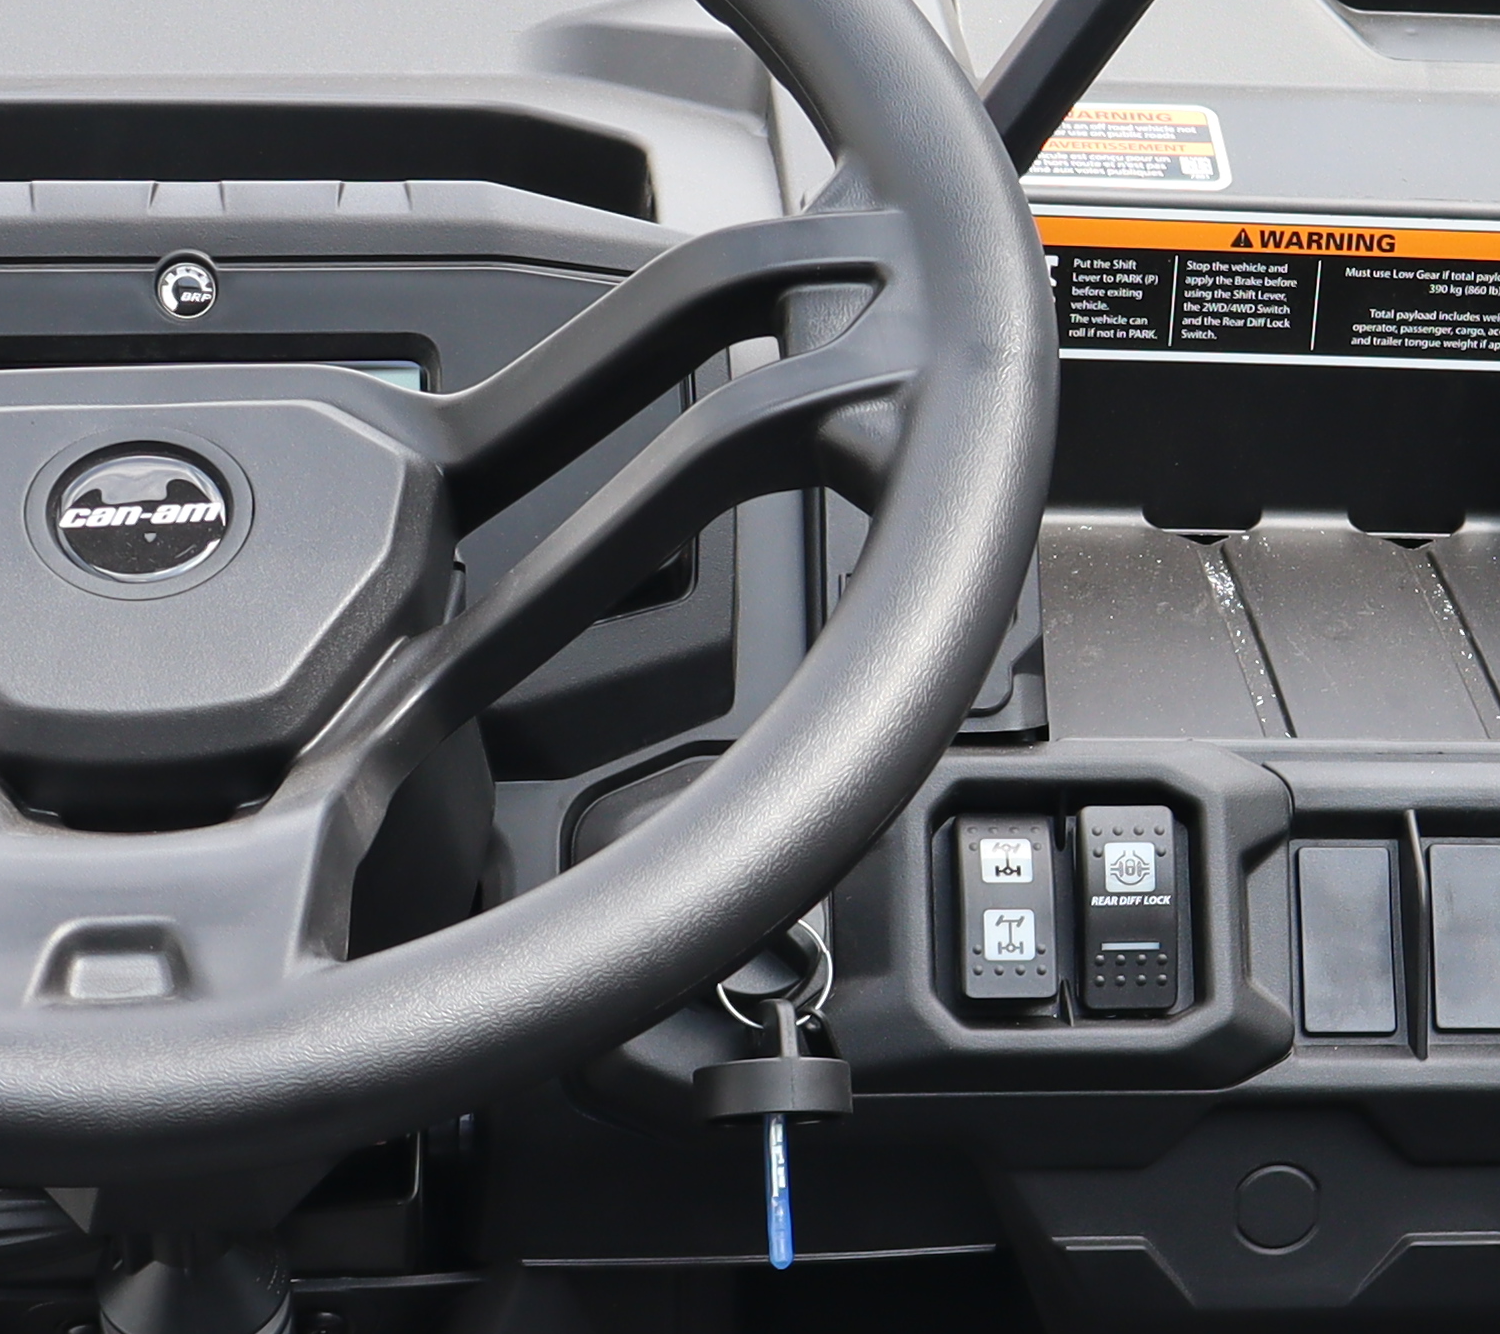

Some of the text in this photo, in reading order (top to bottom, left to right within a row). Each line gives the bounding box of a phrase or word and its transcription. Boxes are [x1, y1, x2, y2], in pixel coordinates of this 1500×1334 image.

[1049, 140, 1187, 153] AVERTISSEMENT
[1260, 230, 1396, 253] WARNING
[1073, 257, 1137, 270] Put the Shift
[1186, 260, 1288, 273] Stop the vehicle and
[1072, 272, 1159, 285] Lever to PARK (P)
[1345, 267, 1371, 278] Must
[1372, 270, 1391, 278] use
[1392, 268, 1415, 279] Low
[1415, 269, 1440, 280] Gear
[1441, 269, 1450, 280] if
[1450, 270, 1475, 281] total
[1184, 274, 1297, 288] apply the Brake before
[1071, 285, 1143, 300] before exiting
[1184, 288, 1212, 301] using
[1213, 288, 1231, 299] the
[1232, 289, 1256, 300] Shift
[1428, 283, 1448, 294] 390
[1449, 283, 1462, 297] kg
[1464, 284, 1487, 295] (860
[1183, 301, 1290, 314] the 2WD/4WD Switch
[1069, 313, 1148, 325] The vehicle can
[1181, 315, 1290, 328] and the Rear Diff Lock
[1369, 308, 1395, 319] Total
[1395, 309, 1437, 322] payload
[1438, 310, 1480, 322] includes
[1068, 327, 1086, 337] roll
[1087, 327, 1095, 337] if
[1096, 329, 1114, 338] not
[1116, 328, 1127, 338] in
[1350, 335, 1371, 345] and
[1372, 336, 1403, 346] trailer
[1404, 337, 1441, 349] tongue
[1442, 338, 1478, 351] weight
[1479, 338, 1488, 349] if
[59, 502, 222, 528] can-am
[1090, 895, 1172, 906] REAR DIFF LOCK
